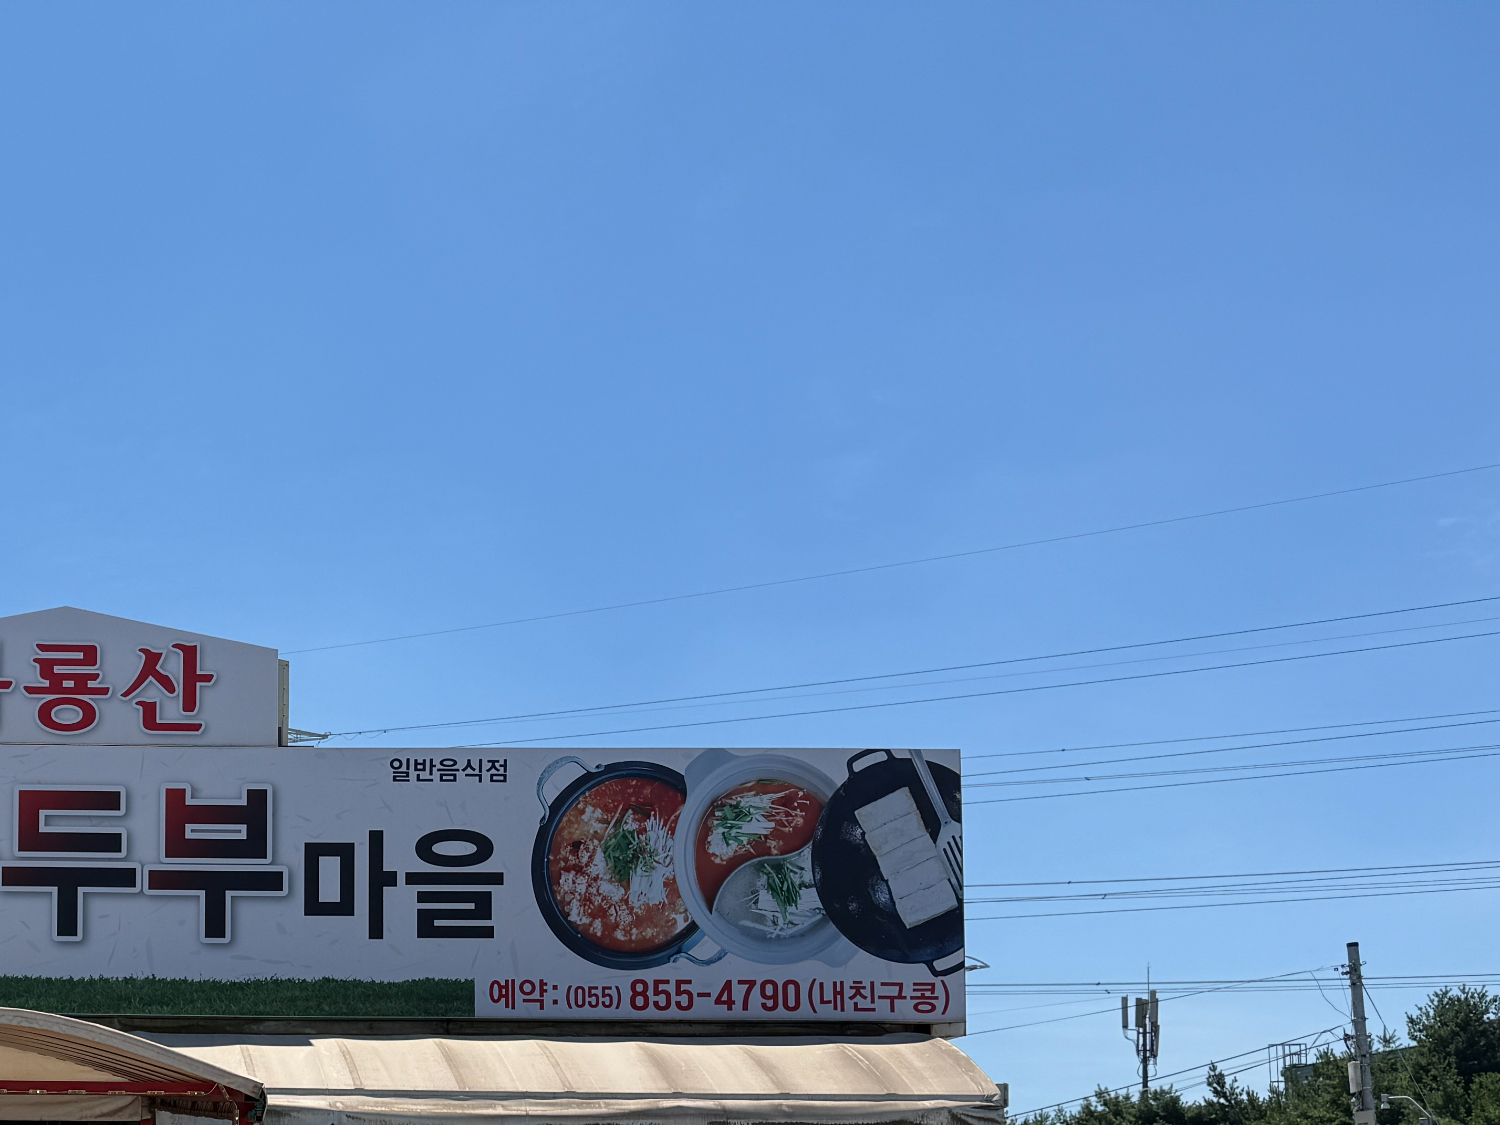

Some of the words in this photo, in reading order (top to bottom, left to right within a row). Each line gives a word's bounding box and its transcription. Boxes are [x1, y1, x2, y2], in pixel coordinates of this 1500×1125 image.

[389, 756, 509, 784] 일반음식점
[565, 984, 622, 1010] (055)
[629, 978, 801, 1013] 855-4790
[807, 979, 951, 1016] (내친구콩)
